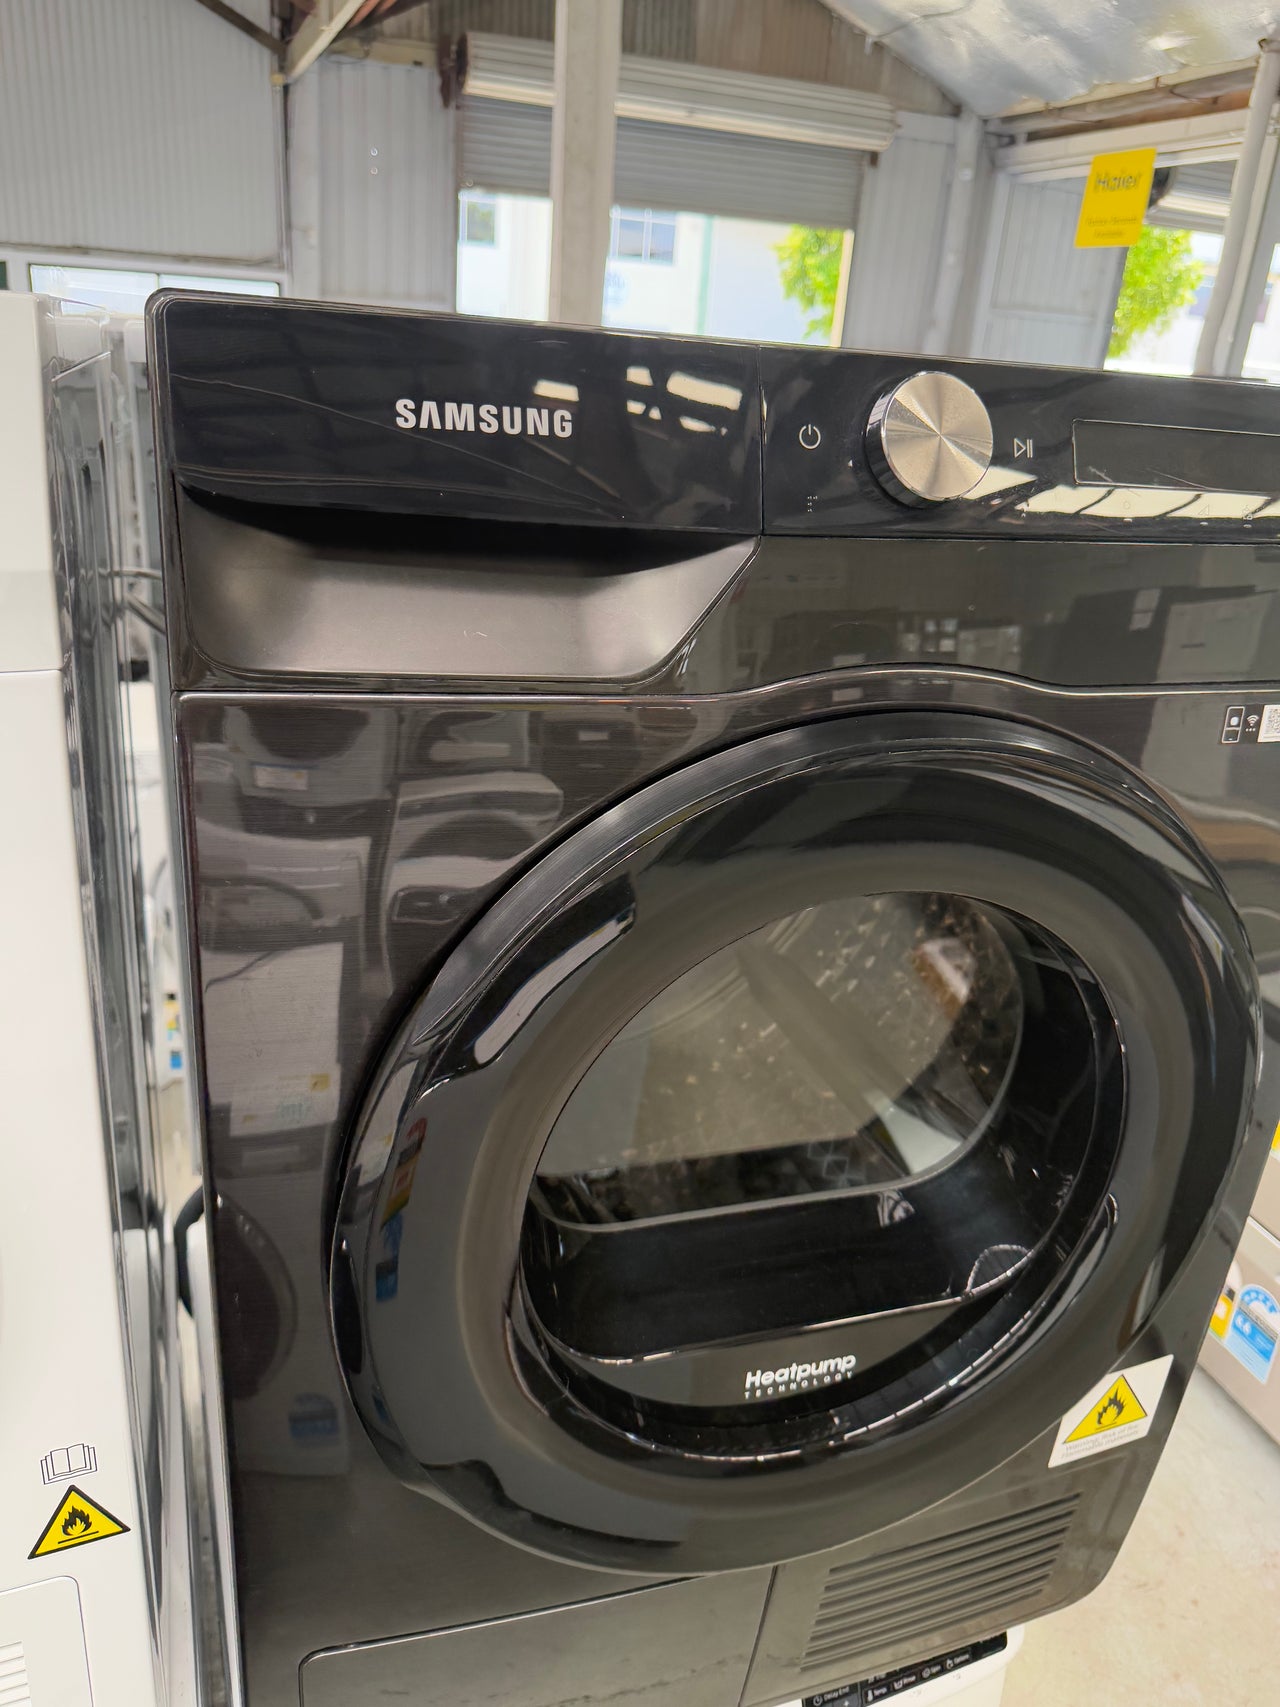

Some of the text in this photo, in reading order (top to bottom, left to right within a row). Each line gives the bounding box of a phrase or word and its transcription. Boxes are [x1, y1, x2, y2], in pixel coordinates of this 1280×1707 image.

[1094, 169, 1143, 192] Haier
[395, 398, 572, 438] SAMSUNG
[744, 1371, 853, 1399] TECHNOLOGY
[745, 1354, 856, 1389] Heatpump
